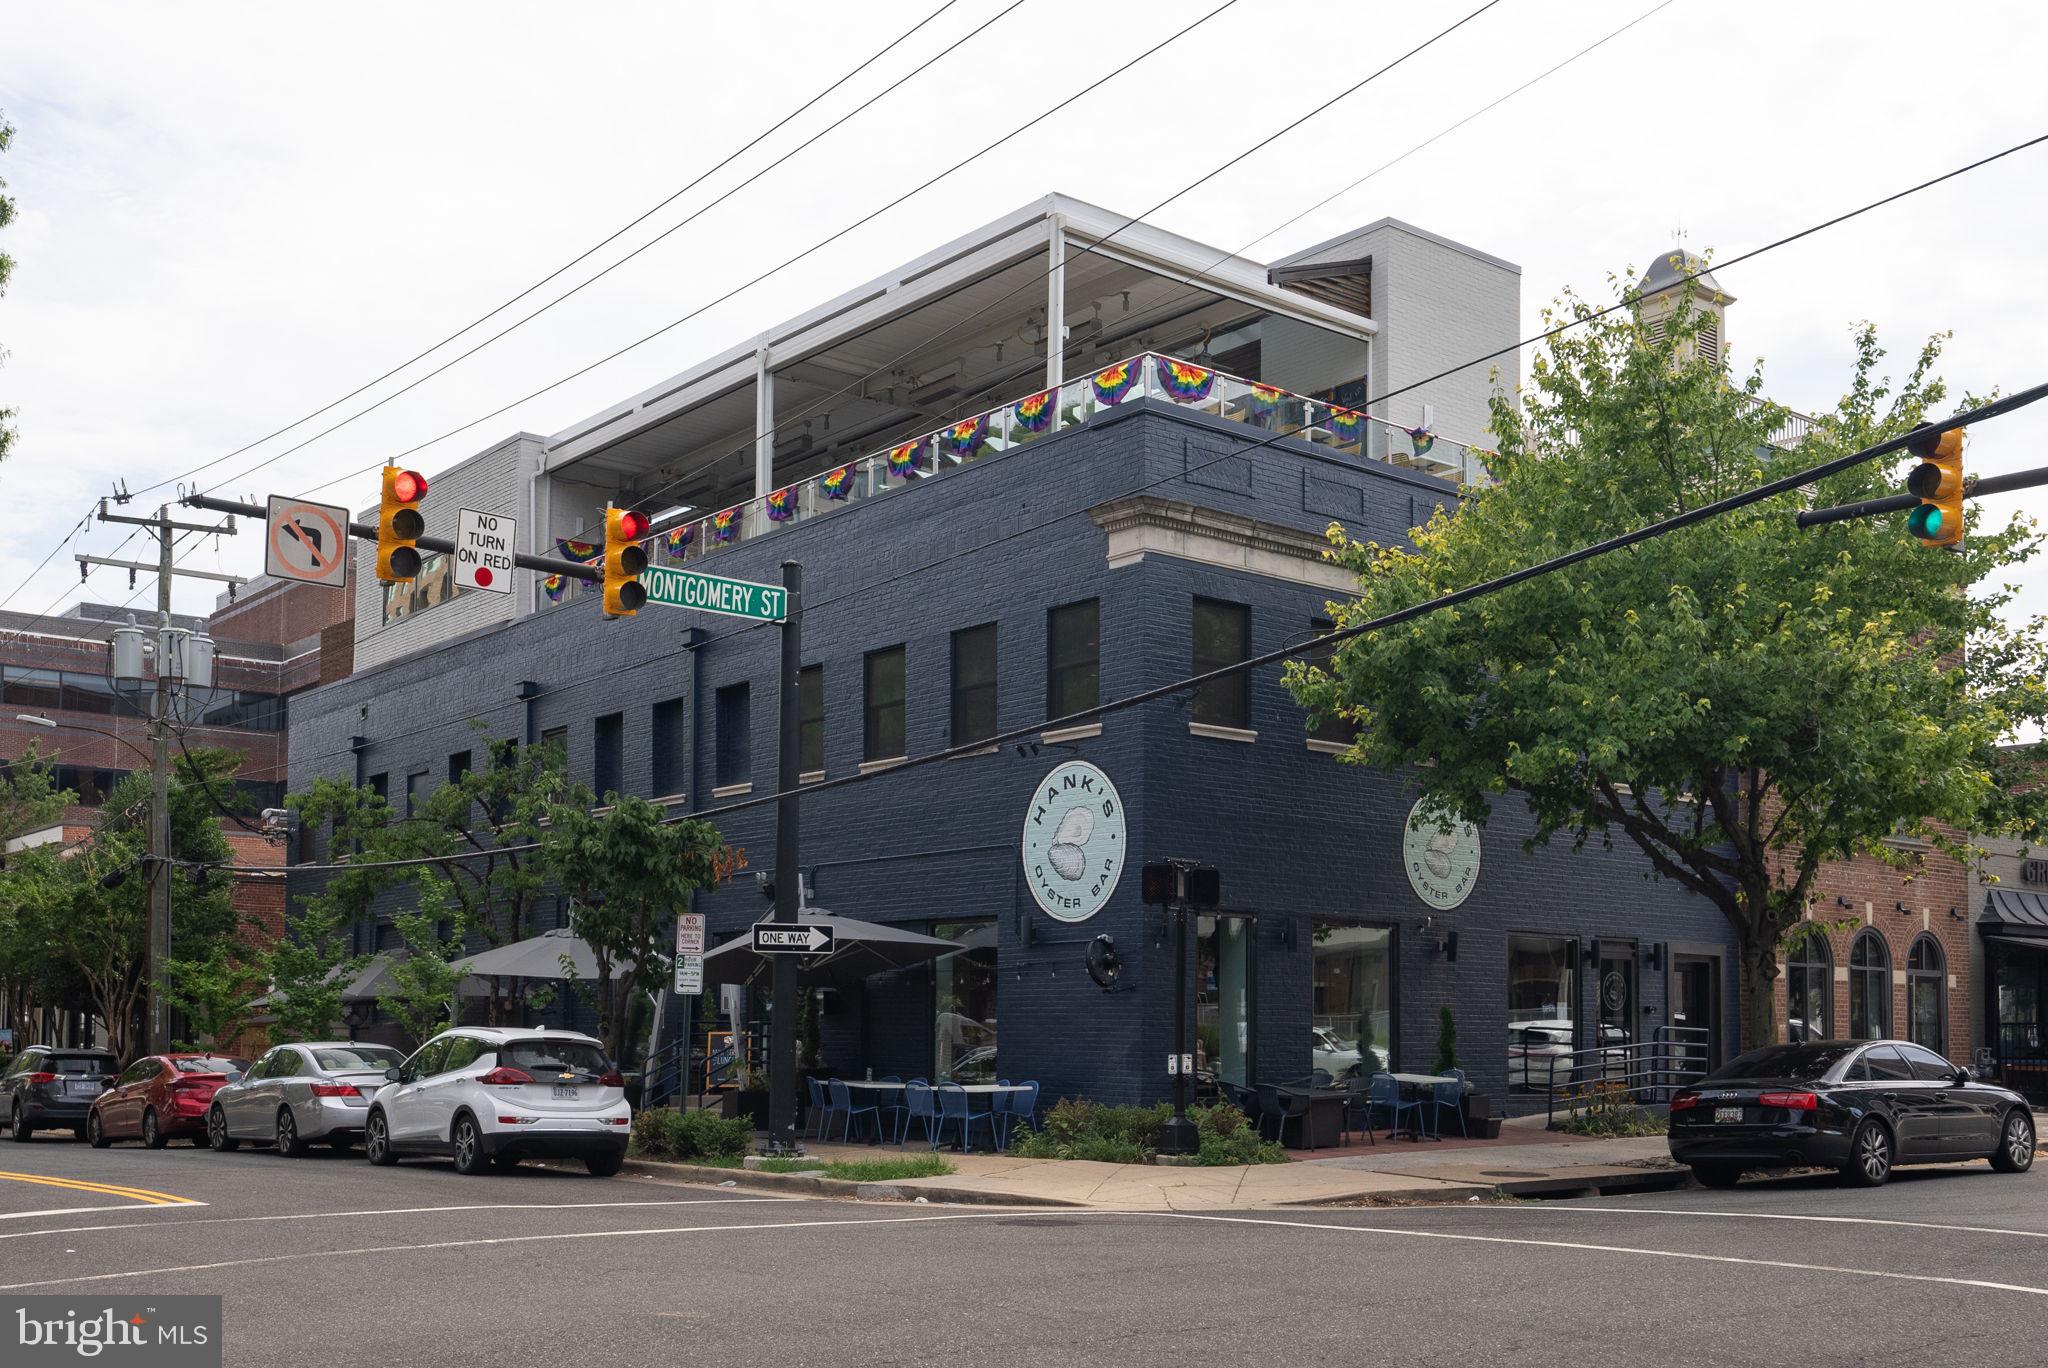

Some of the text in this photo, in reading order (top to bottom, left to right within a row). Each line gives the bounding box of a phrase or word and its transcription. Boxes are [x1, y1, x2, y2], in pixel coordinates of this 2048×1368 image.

[478, 515, 498, 531] NO
[469, 531, 505, 551] TURN
[458, 547, 511, 570] ON RED
[639, 570, 781, 617] MONTGOMERY ST
[1033, 773, 1114, 826] HANK'S
[1413, 862, 1472, 899] OYSTER BAR
[2025, 861, 2048, 882] GR
[1035, 858, 1114, 908] OYSTER BAR
[680, 924, 702, 932] PARKING
[685, 917, 697, 925] NO
[762, 932, 810, 944] ONE WAY
[677, 957, 684, 967] 2
